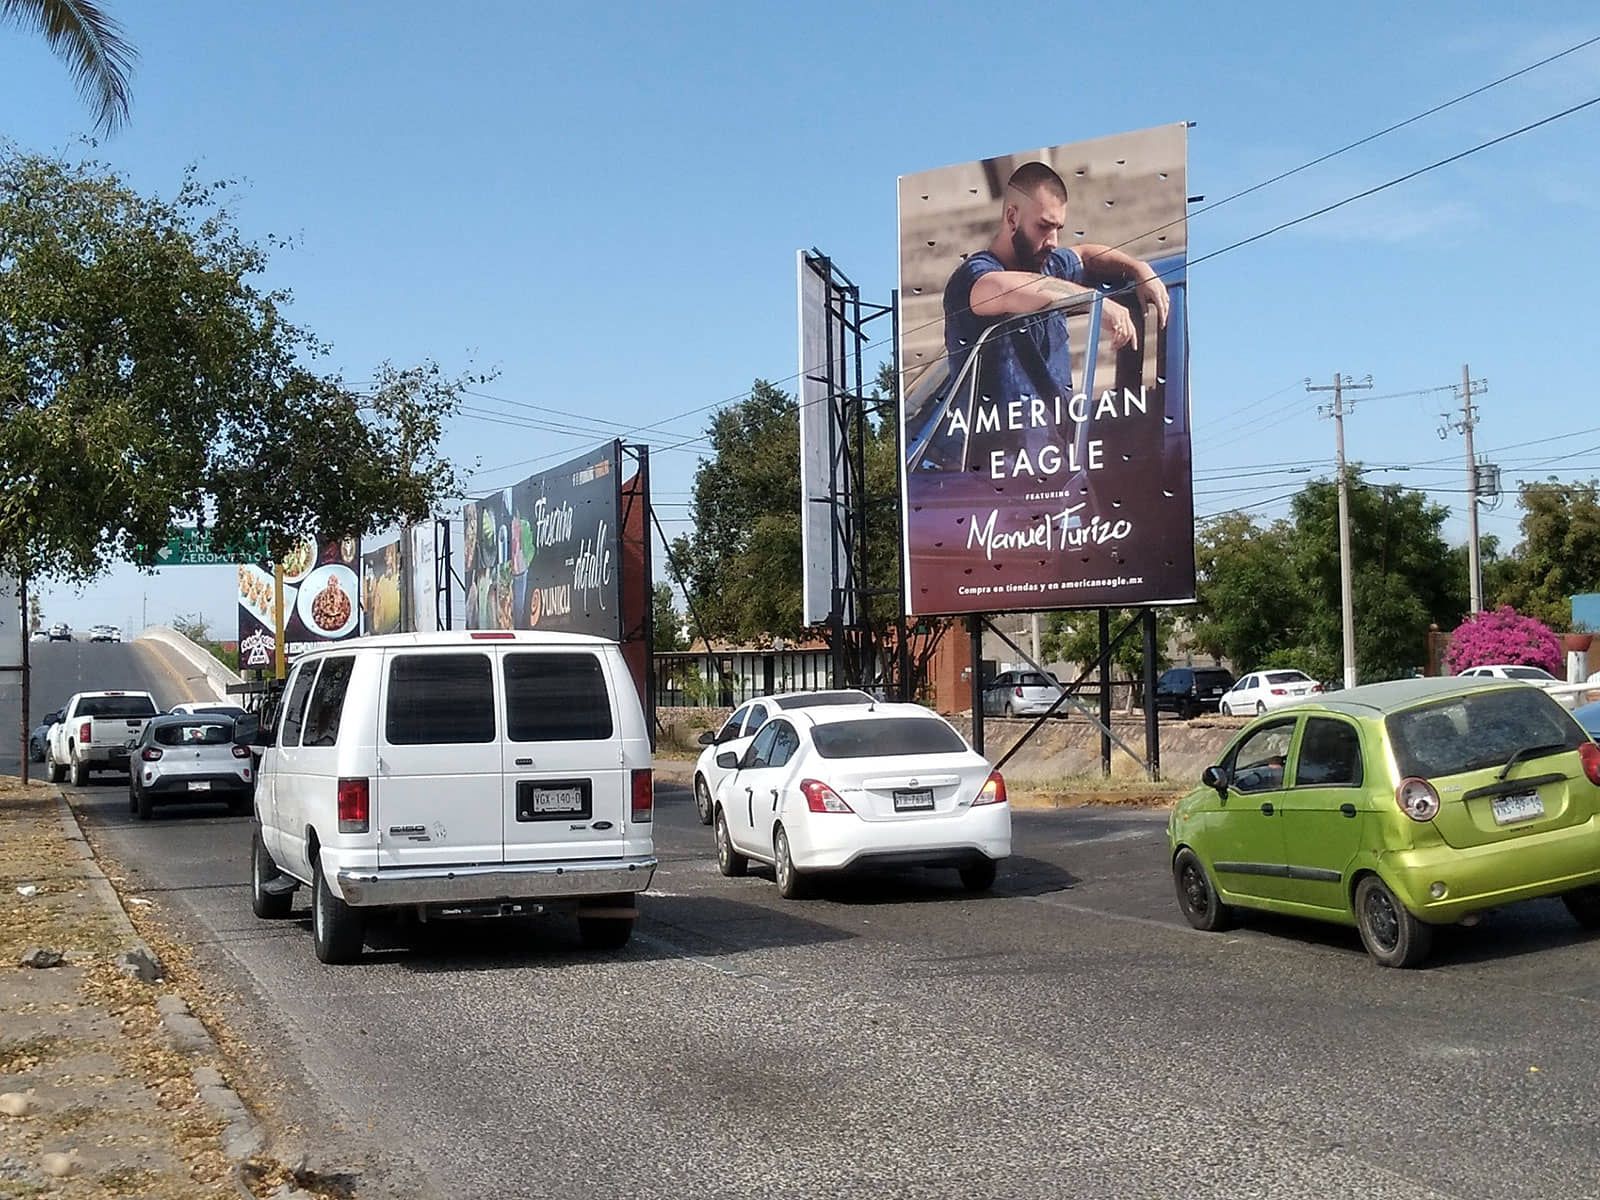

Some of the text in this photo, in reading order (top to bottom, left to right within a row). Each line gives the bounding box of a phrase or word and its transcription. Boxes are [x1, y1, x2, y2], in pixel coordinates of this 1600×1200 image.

[947, 385, 1148, 437] AMERICAN
[990, 440, 1105, 480] EAGLE
[1025, 490, 1071, 501] FEATURING
[966, 502, 1132, 561] Manuel Turizo
[958, 576, 1143, 597] Compra en tiendas y en americaneagle.mx
